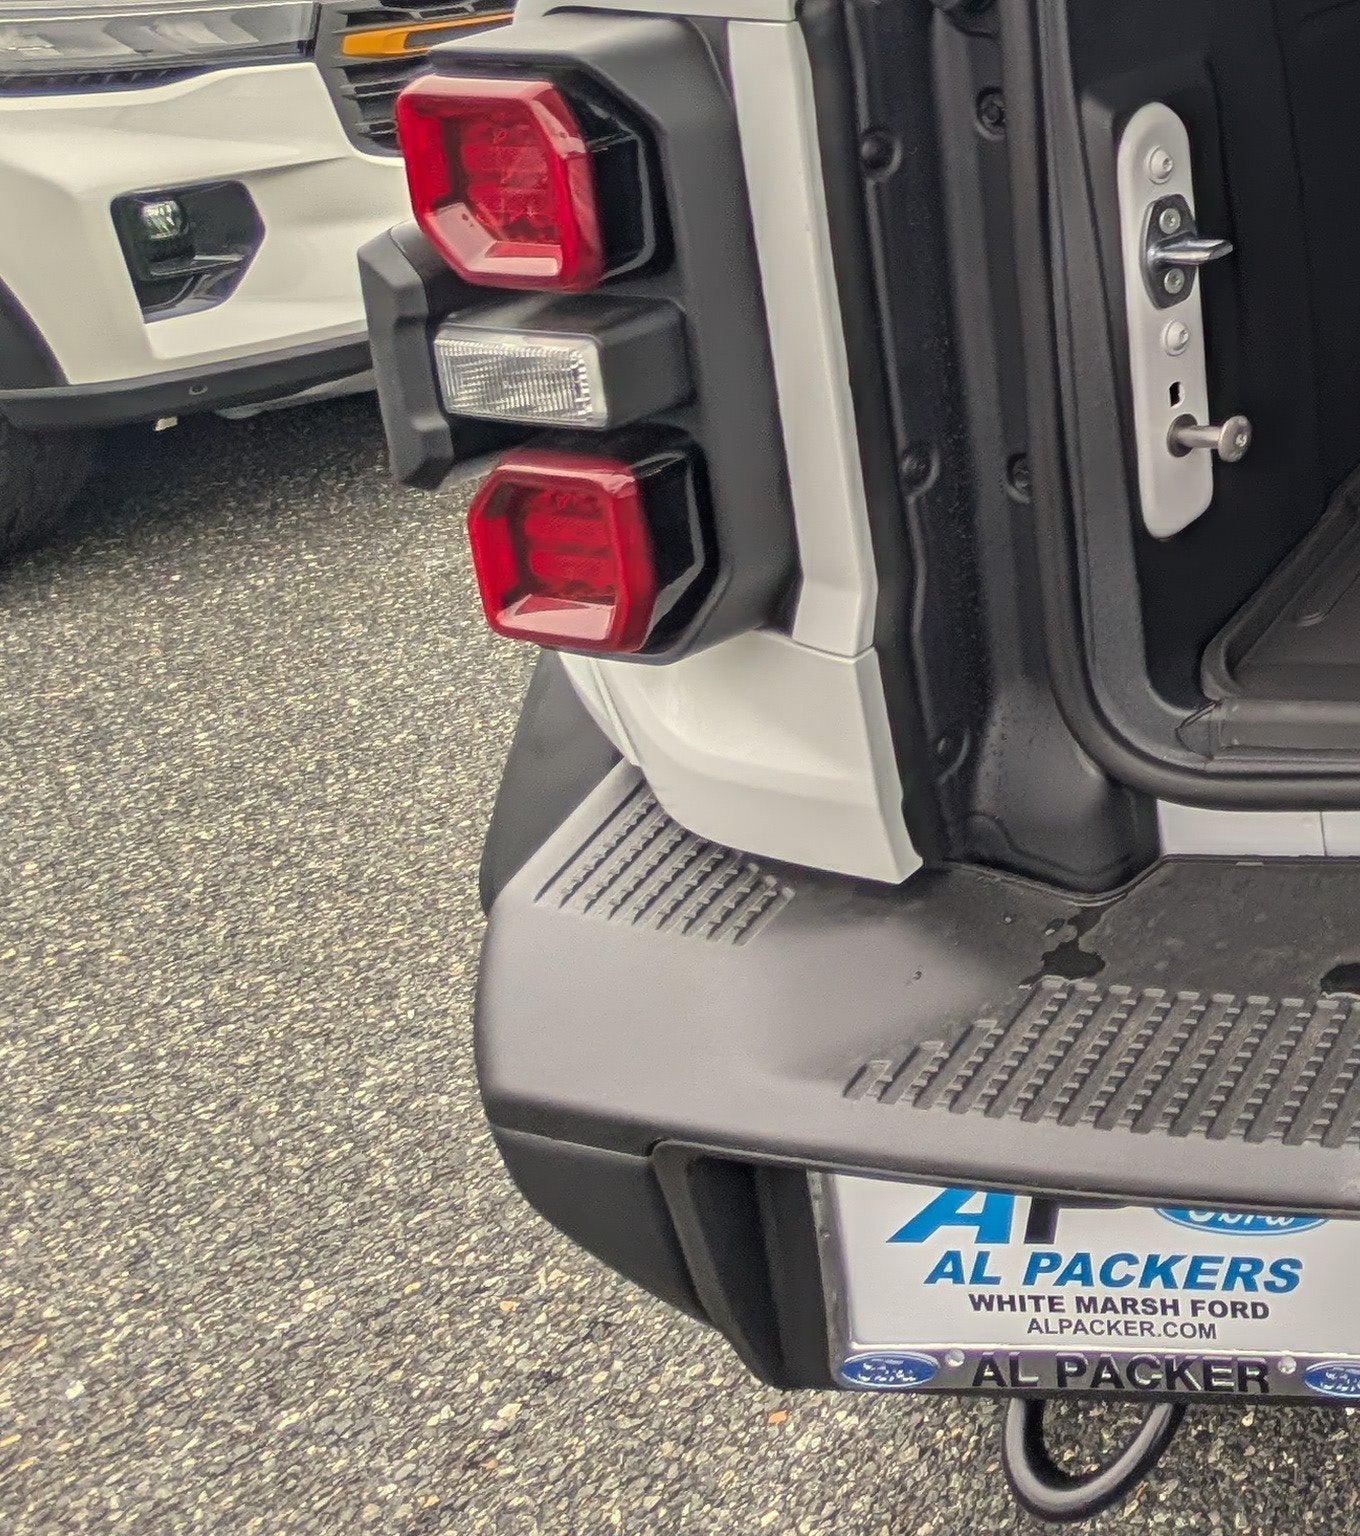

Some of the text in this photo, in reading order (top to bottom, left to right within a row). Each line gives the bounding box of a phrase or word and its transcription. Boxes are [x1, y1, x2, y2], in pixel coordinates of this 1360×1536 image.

[924, 1250, 1303, 1294] AL PACKERS
[968, 1293, 1270, 1319] WHITE MARSH FORD
[1026, 1318, 1218, 1340] ALPACKER.COM
[972, 1350, 1271, 1395] AL PACKER
